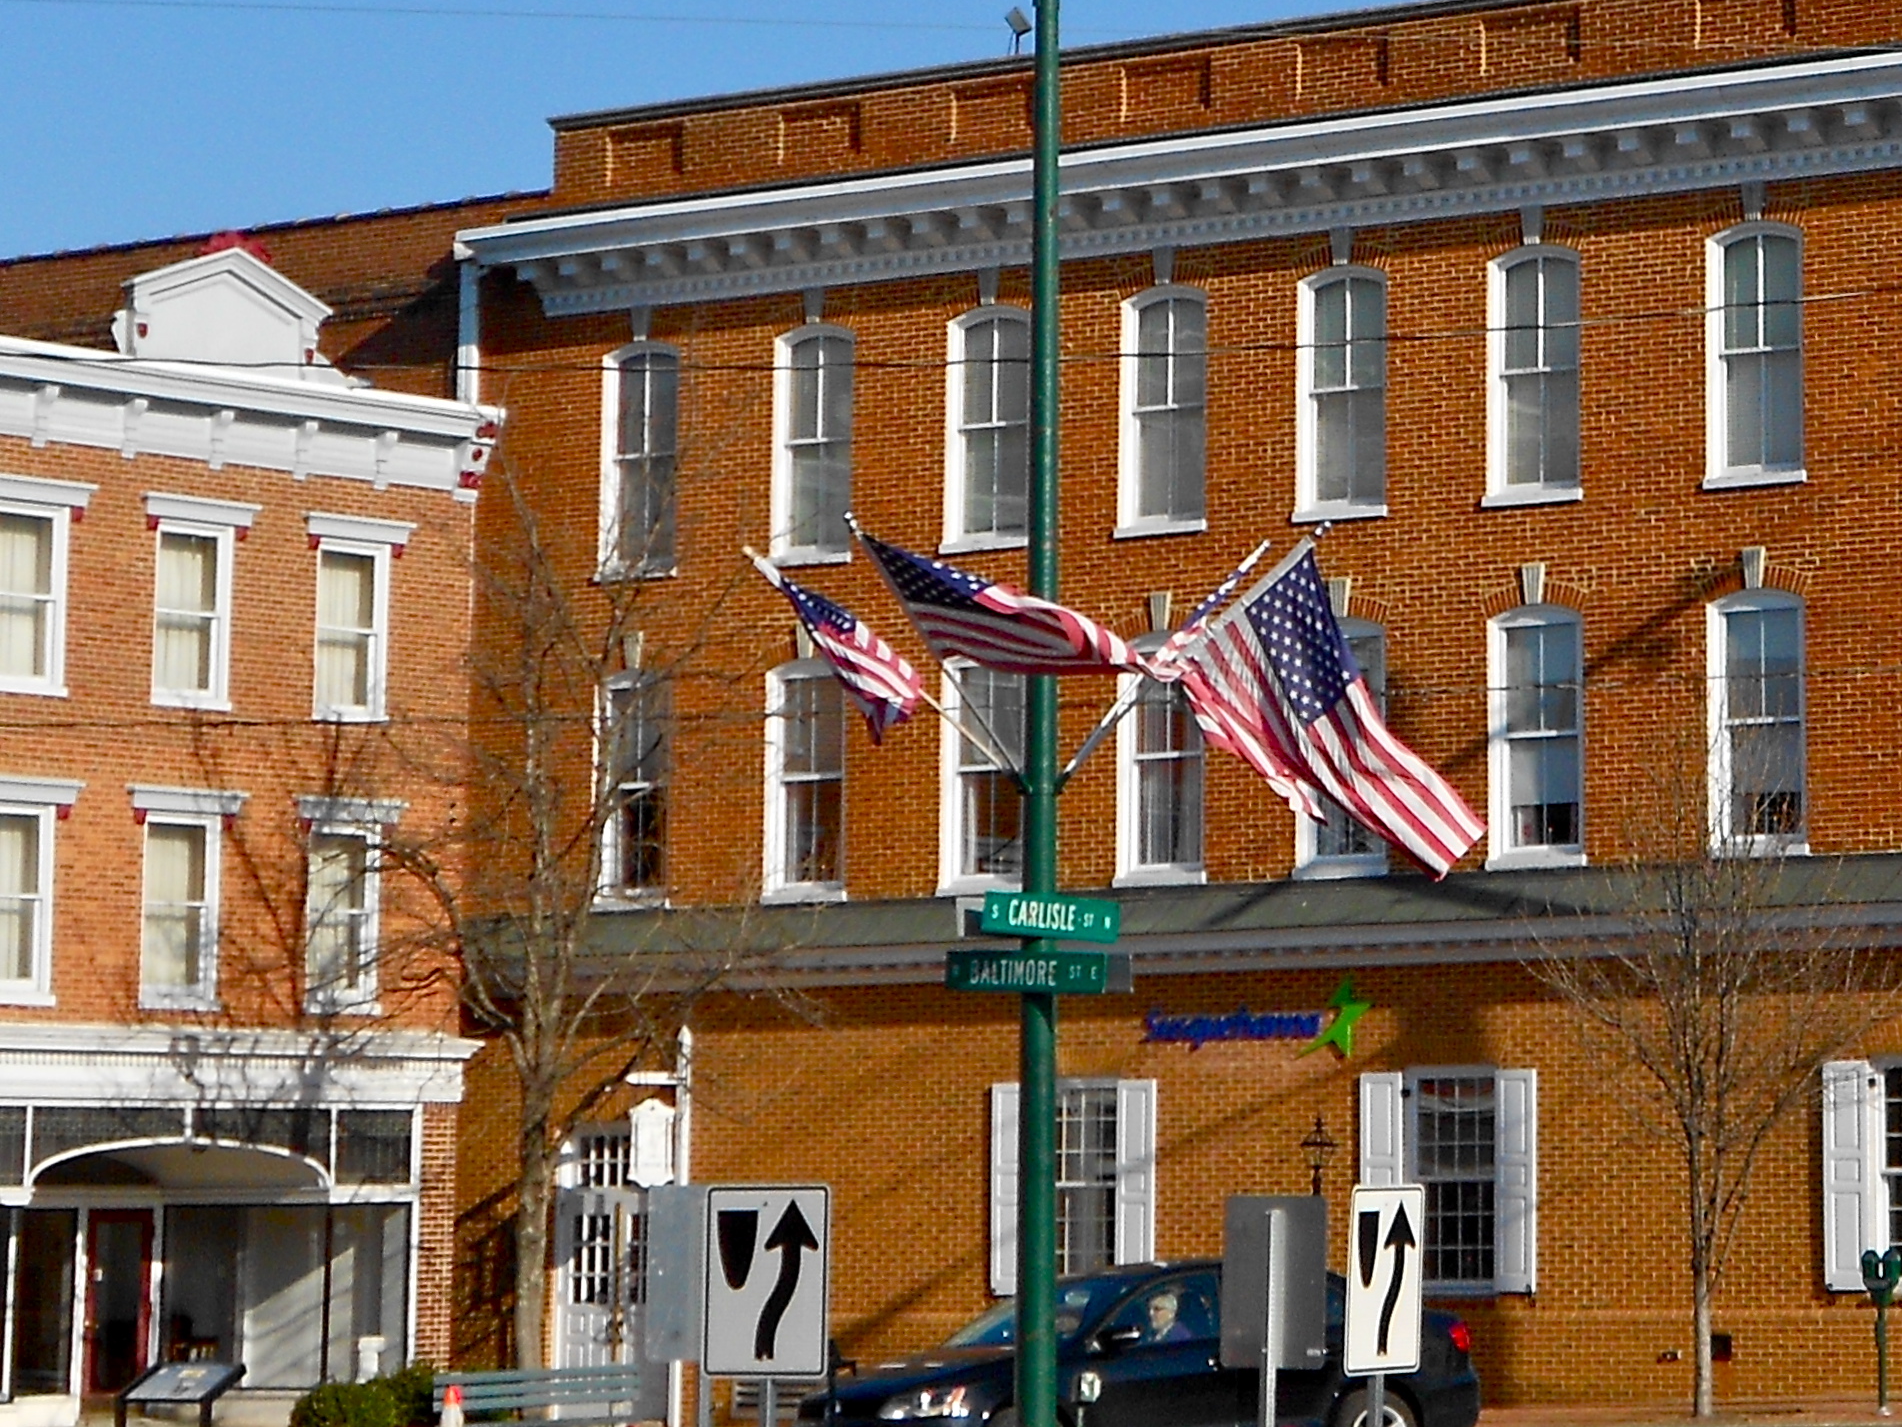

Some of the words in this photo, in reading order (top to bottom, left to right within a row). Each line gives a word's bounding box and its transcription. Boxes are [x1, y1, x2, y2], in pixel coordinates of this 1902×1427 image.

[992, 904, 998, 919] S
[1008, 899, 1077, 932] CARLISLE
[1083, 913, 1094, 927] ST
[969, 959, 1058, 986] BALTIMORE
[1069, 965, 1081, 979] ST
[1090, 966, 1097, 980] E
